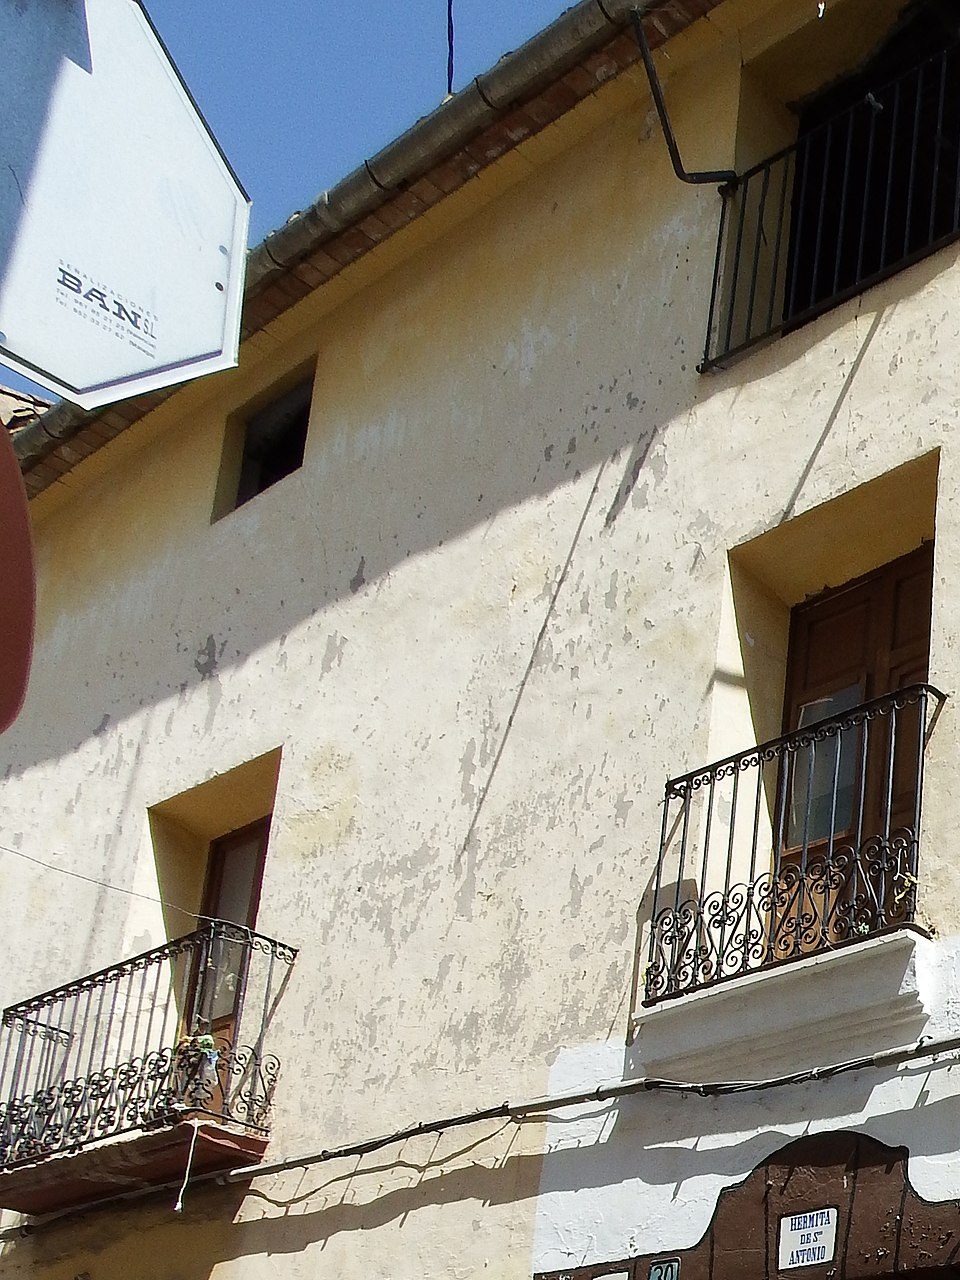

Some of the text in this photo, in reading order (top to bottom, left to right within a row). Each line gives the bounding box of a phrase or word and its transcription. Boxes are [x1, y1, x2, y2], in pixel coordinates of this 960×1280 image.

[57, 267, 141, 330] BAN
[790, 1210, 831, 1232] HERMITA
[800, 1233, 812, 1245] DE
[789, 1245, 826, 1266] ANTONIO
